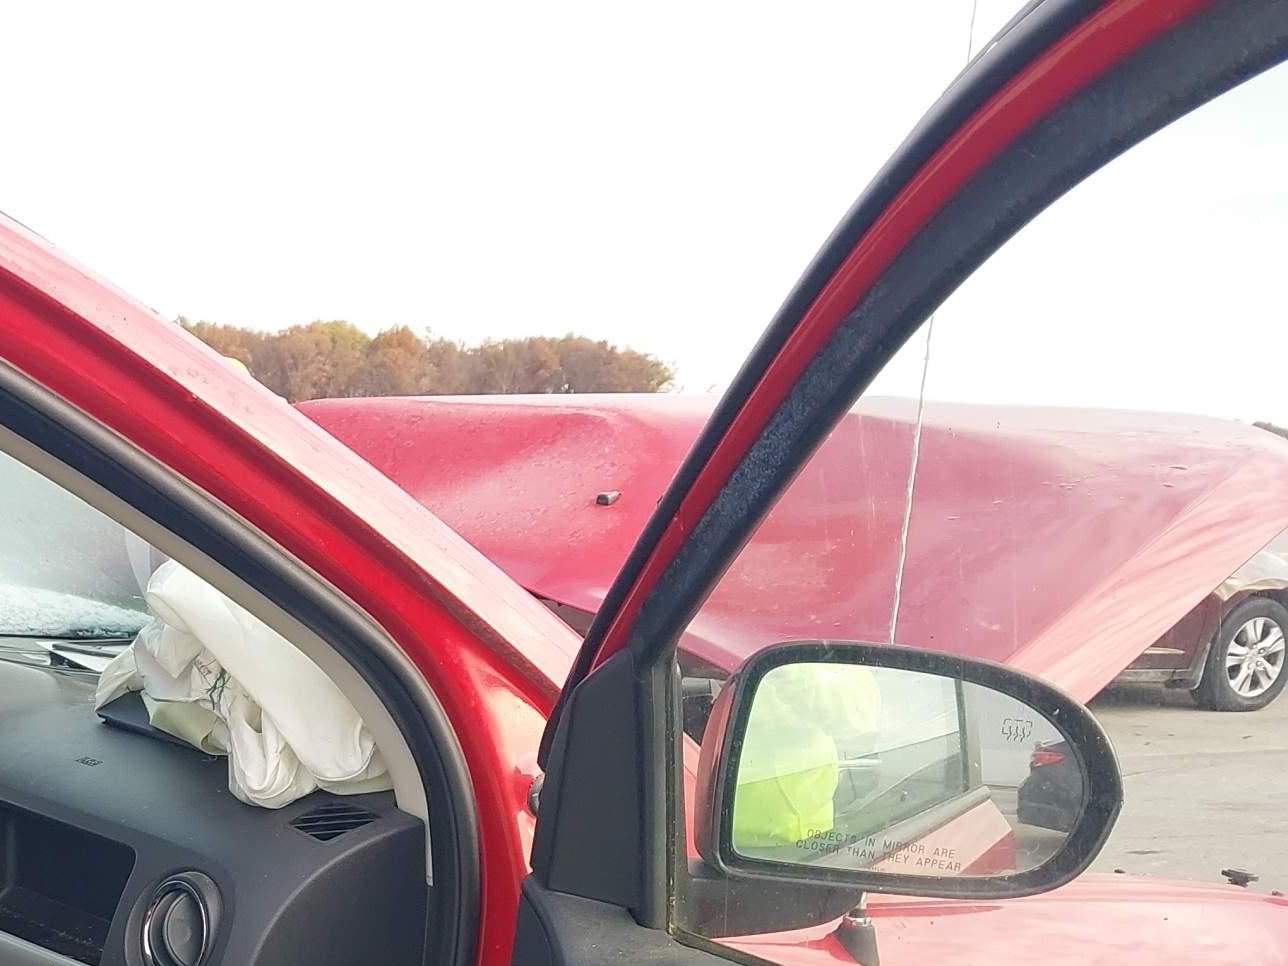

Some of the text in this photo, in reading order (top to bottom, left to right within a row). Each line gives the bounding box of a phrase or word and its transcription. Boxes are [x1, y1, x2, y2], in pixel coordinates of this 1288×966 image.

[796, 839, 841, 854] CLOSER
[847, 846, 875, 859] THAN
[916, 855, 961, 872] APPEAR
[807, 828, 957, 859] OBJECTS IN MIRROR ARE
